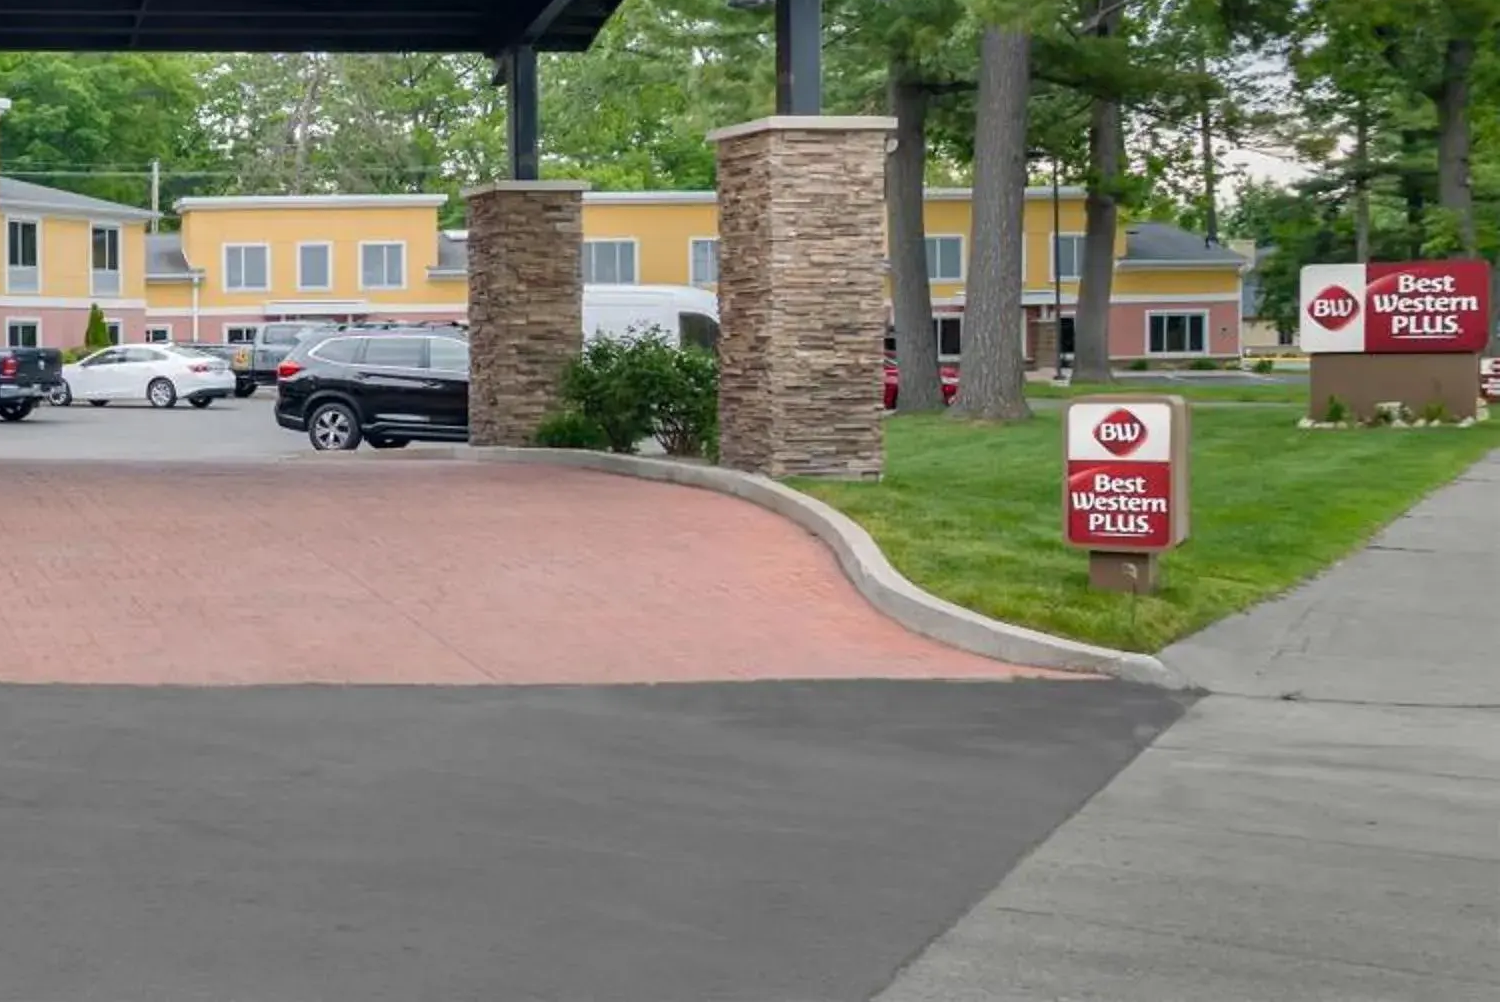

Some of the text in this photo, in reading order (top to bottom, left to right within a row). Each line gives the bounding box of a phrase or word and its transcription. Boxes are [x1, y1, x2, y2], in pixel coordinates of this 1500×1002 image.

[1398, 274, 1456, 293] Best
[1313, 299, 1353, 317] BW
[1373, 295, 1479, 313] Western
[1100, 422, 1140, 442] BW
[1094, 474, 1146, 493] Best
[1072, 492, 1168, 512] Western
